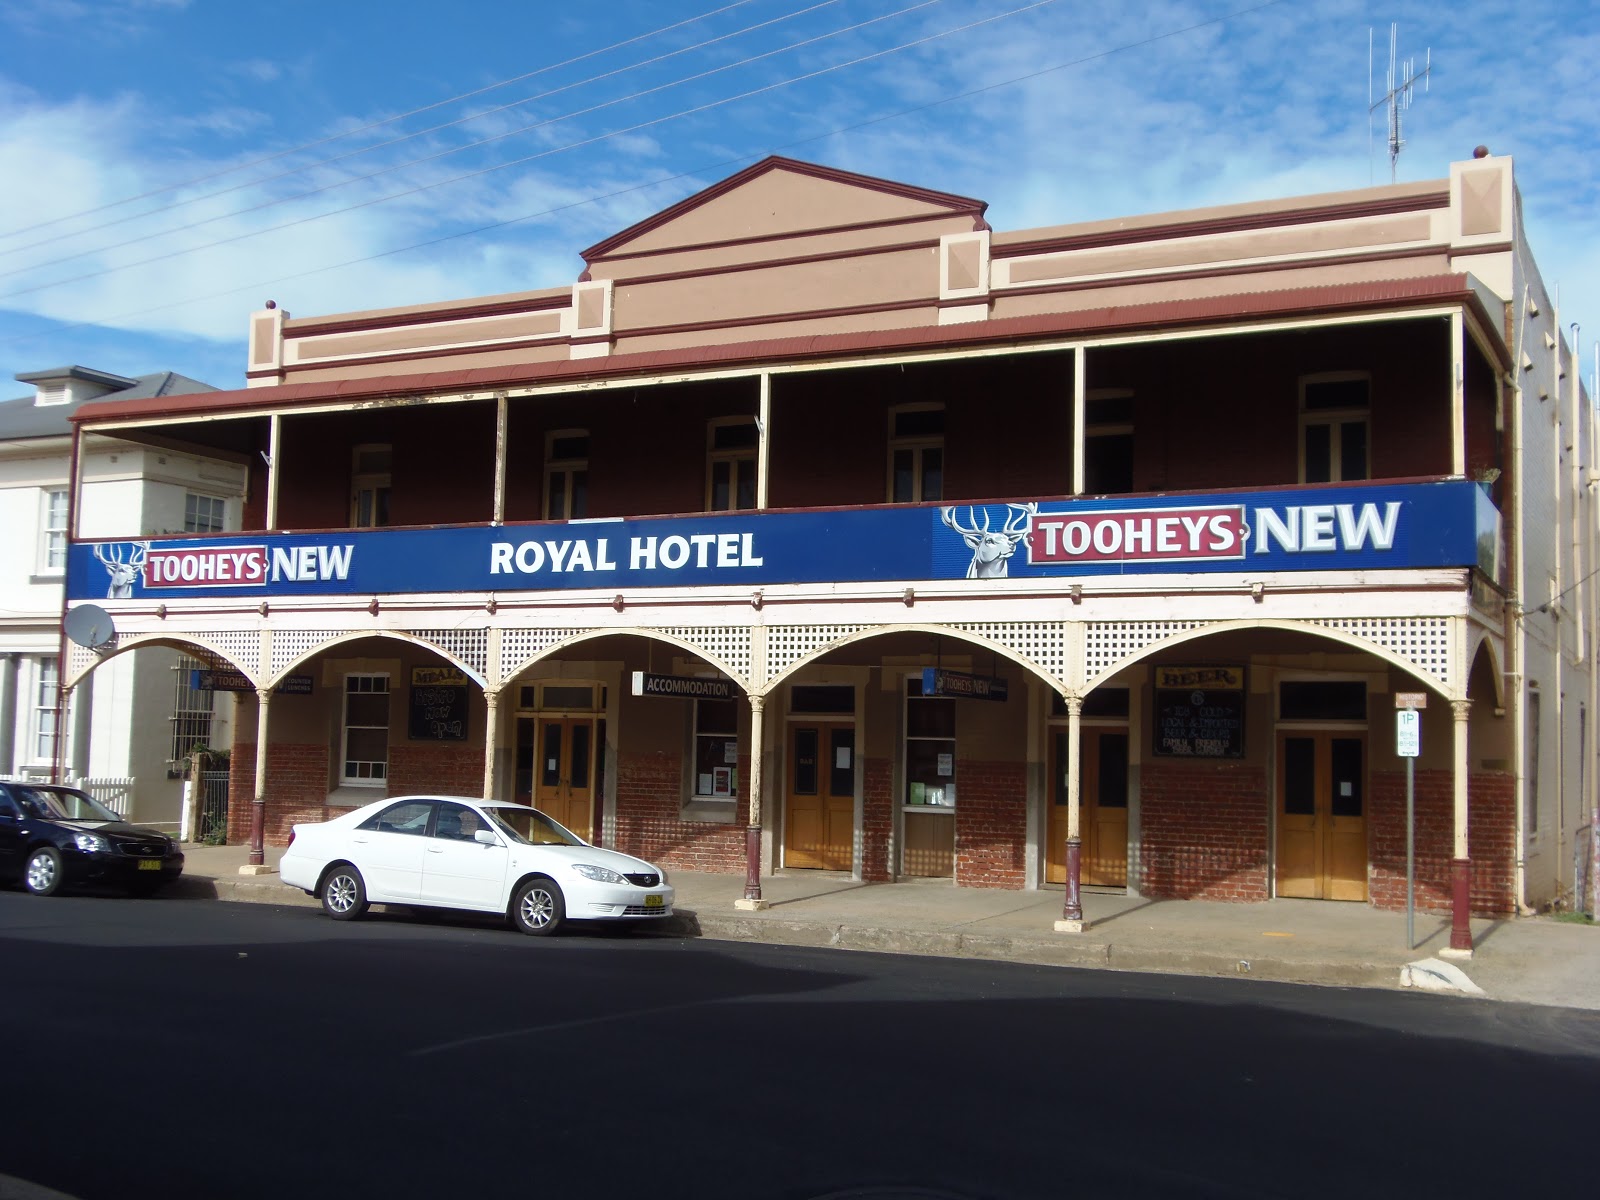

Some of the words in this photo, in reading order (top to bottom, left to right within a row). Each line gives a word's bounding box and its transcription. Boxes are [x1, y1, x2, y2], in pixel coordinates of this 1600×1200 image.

[1038, 515, 1235, 556] TOOHEYS
[1254, 501, 1403, 554] NEW
[490, 538, 617, 574] ROYAL
[629, 533, 764, 570] HOTEL
[149, 552, 261, 582] TOOHEYS
[271, 545, 355, 582] NEW
[217, 676, 254, 688] TOOHEY
[647, 677, 729, 696] ACCOMMODATION
[946, 677, 972, 692] TOOHEYS
[973, 679, 992, 695] NEW
[1162, 669, 1237, 686] BEER
[1402, 712, 1415, 725] 1P
